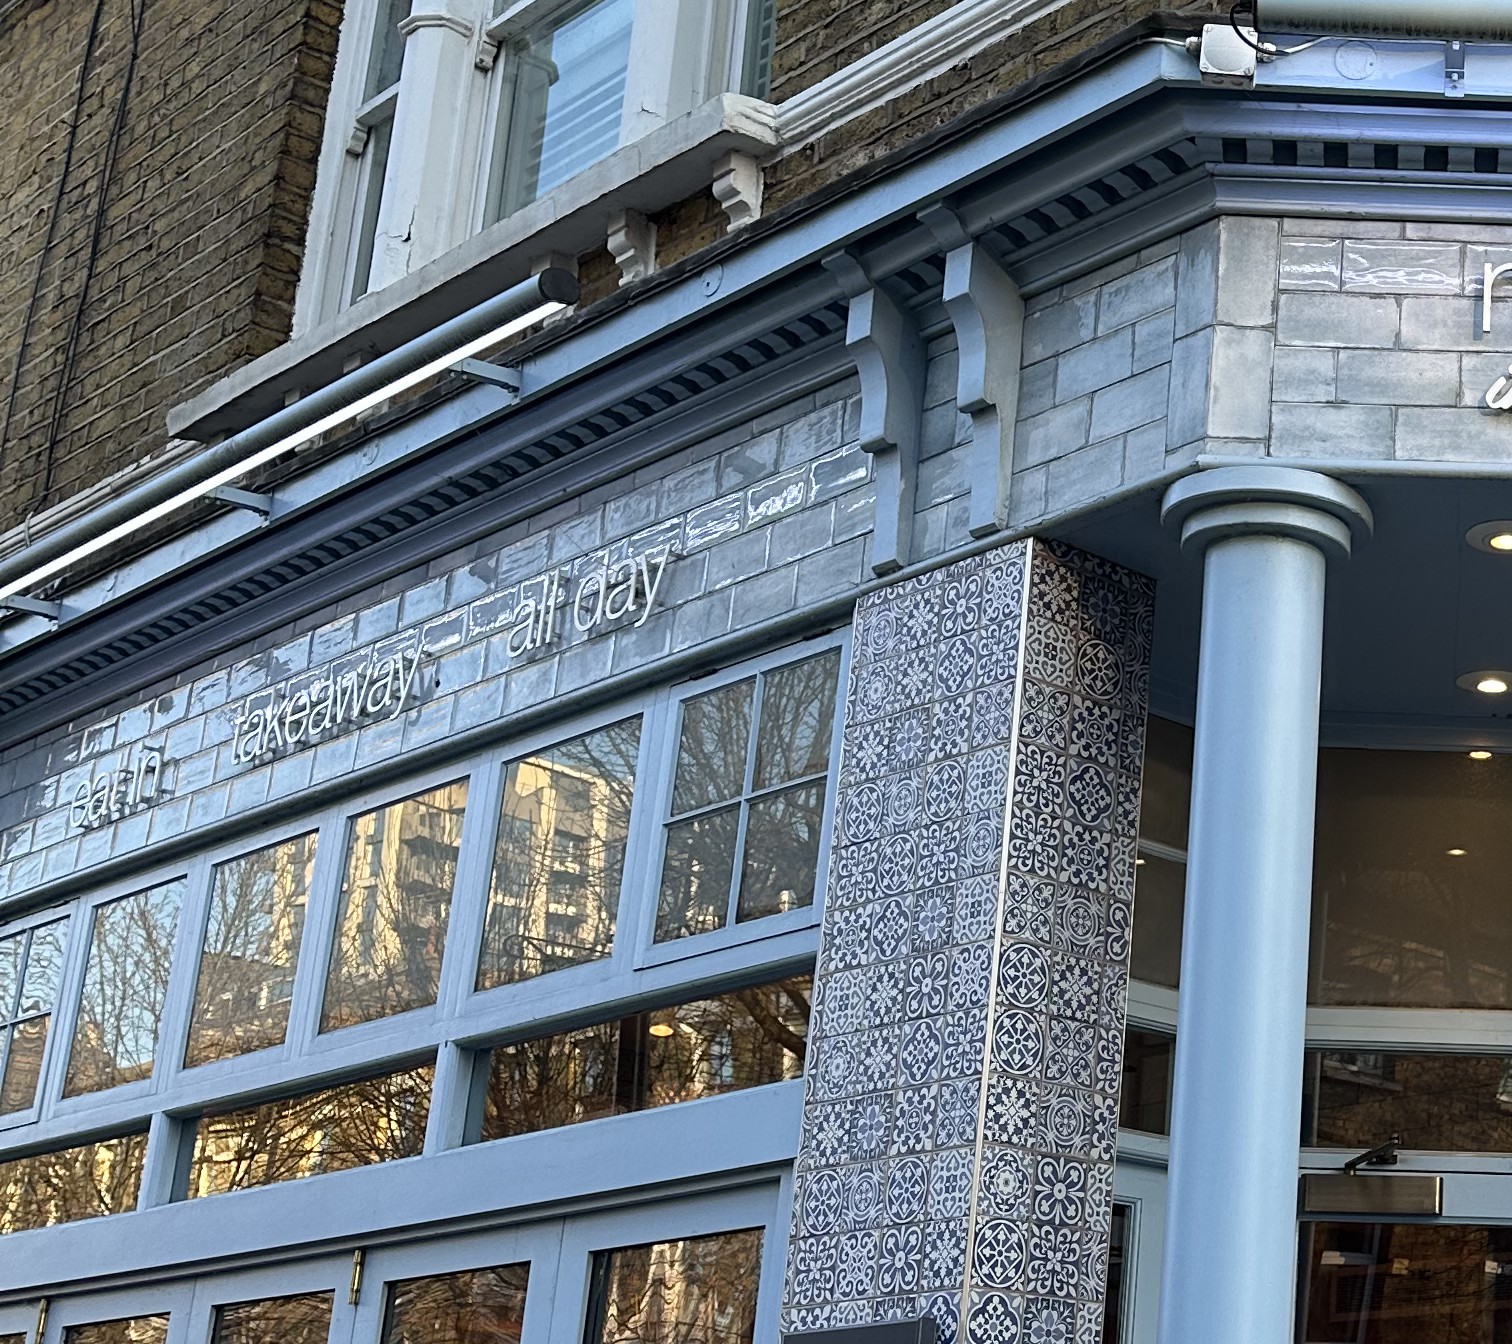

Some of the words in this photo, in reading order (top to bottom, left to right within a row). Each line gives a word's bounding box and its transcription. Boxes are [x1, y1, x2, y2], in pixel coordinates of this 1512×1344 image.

[506, 569, 560, 658] all
[573, 542, 672, 632] day
[231, 643, 425, 765] takeaway
[69, 753, 122, 828] eat
[128, 740, 160, 806] in
